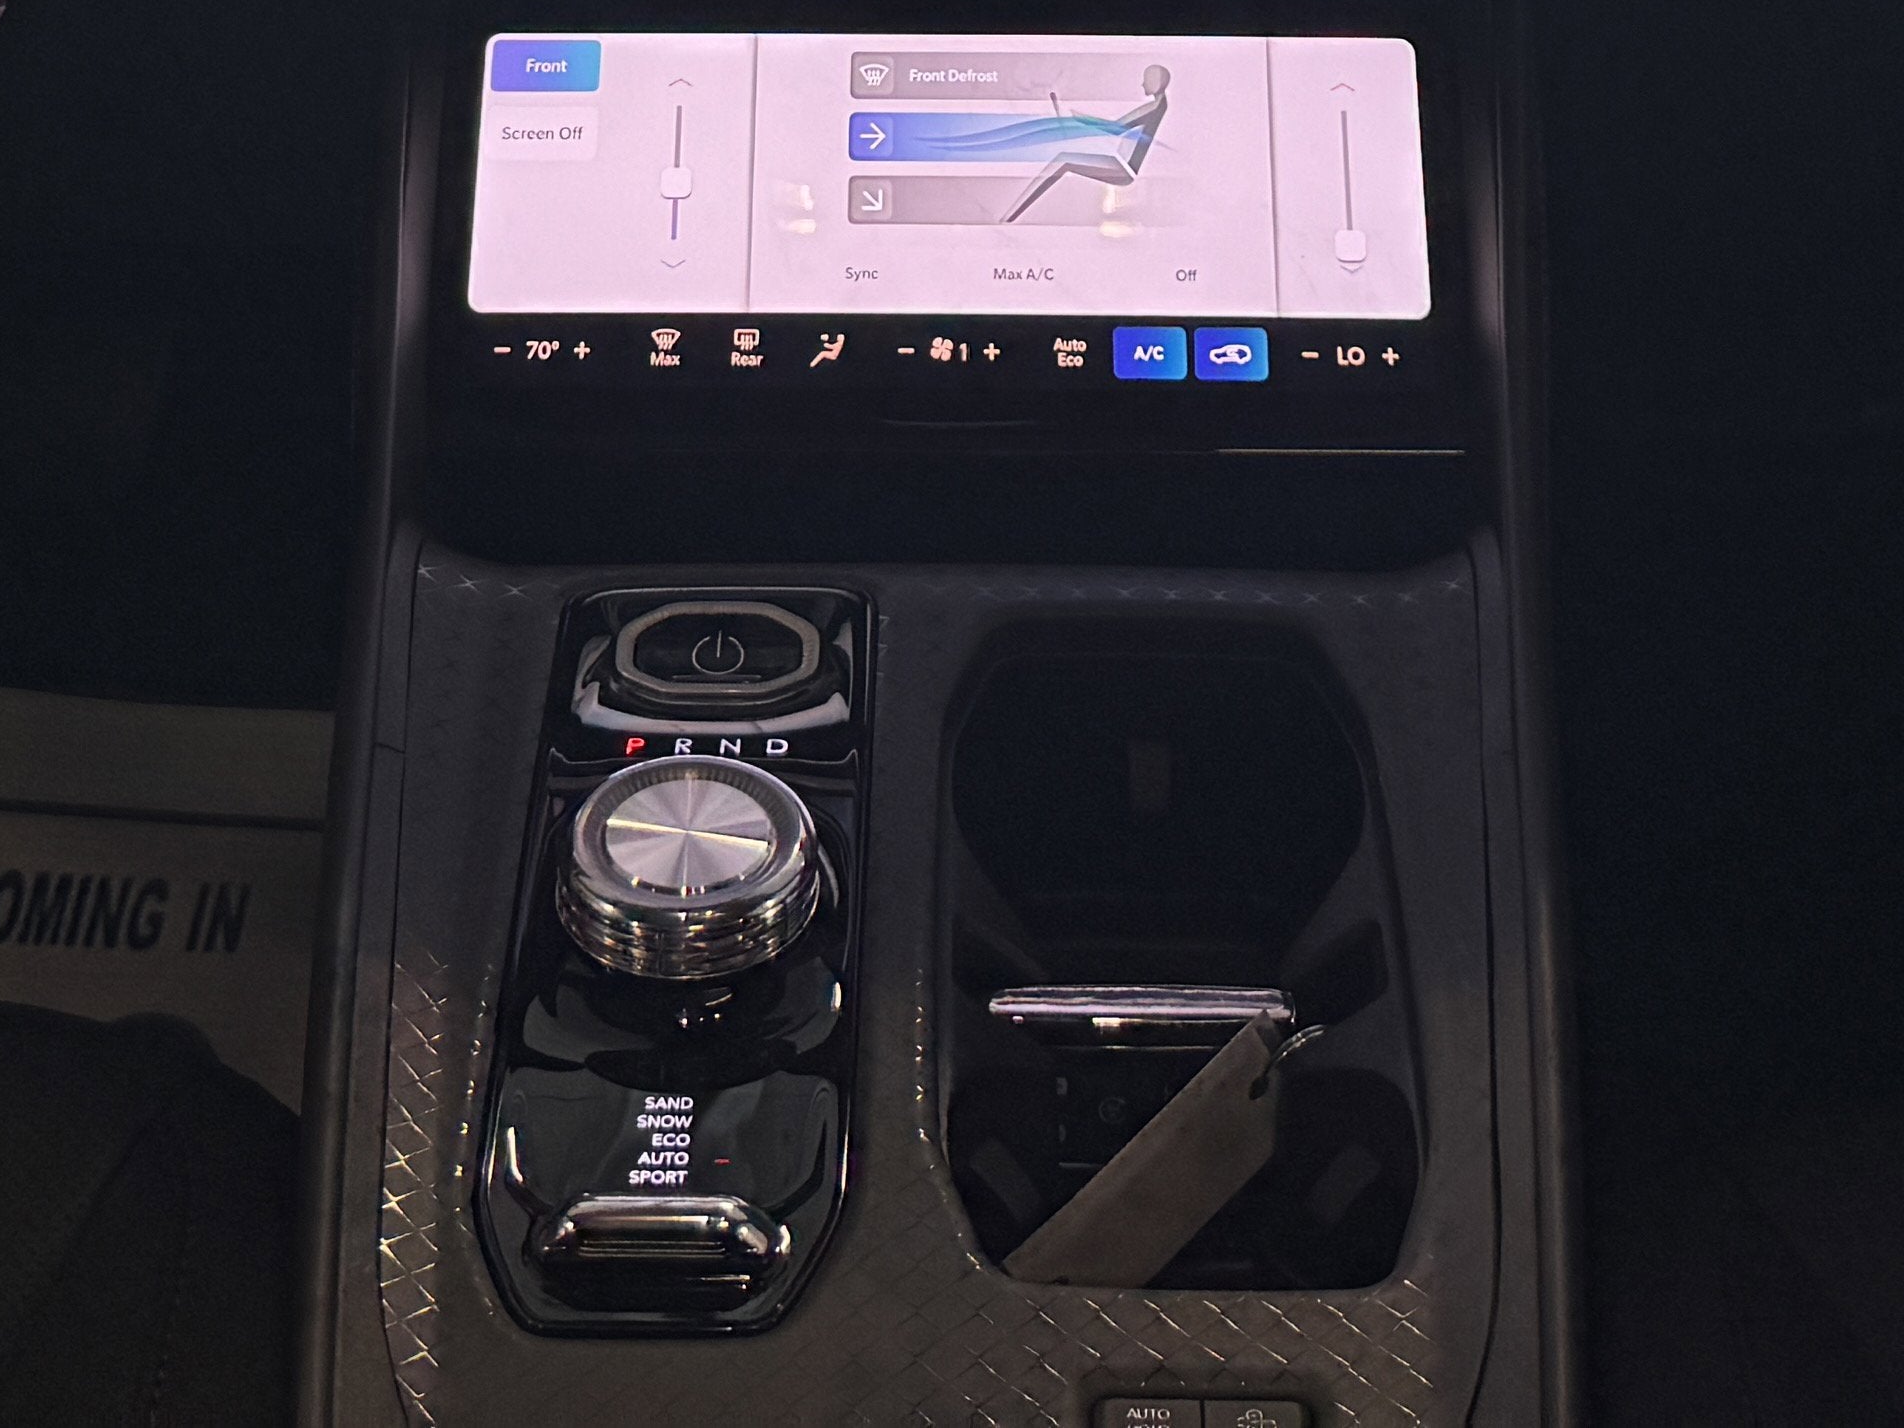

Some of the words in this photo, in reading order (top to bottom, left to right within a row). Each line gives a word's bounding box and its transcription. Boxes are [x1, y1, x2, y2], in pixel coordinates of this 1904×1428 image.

[526, 58, 568, 72] Front
[909, 69, 946, 82] Front
[948, 68, 998, 83] Defrost
[501, 126, 554, 140] Screen
[559, 126, 584, 140] Off
[845, 267, 879, 282] Sync
[993, 268, 1023, 281] Max
[1026, 267, 1055, 282] A/C
[1175, 269, 1198, 282] Off
[1053, 337, 1088, 353] Auto
[650, 352, 681, 366] Max
[731, 352, 764, 367] Rear
[1057, 353, 1084, 368] Eco
[1133, 344, 1165, 362] A/C
[1336, 346, 1366, 366] LO
[624, 736, 646, 756] P
[674, 737, 694, 756] R
[719, 738, 742, 756] N
[765, 738, 789, 756] D
[187, 881, 251, 953] IN
[645, 1096, 694, 1110] SAND
[636, 1114, 694, 1129] SNOW
[651, 1133, 691, 1147] ECO
[637, 1150, 690, 1166] AUTO
[628, 1169, 689, 1185] SPORT
[1125, 1407, 1171, 1420] AUTO
